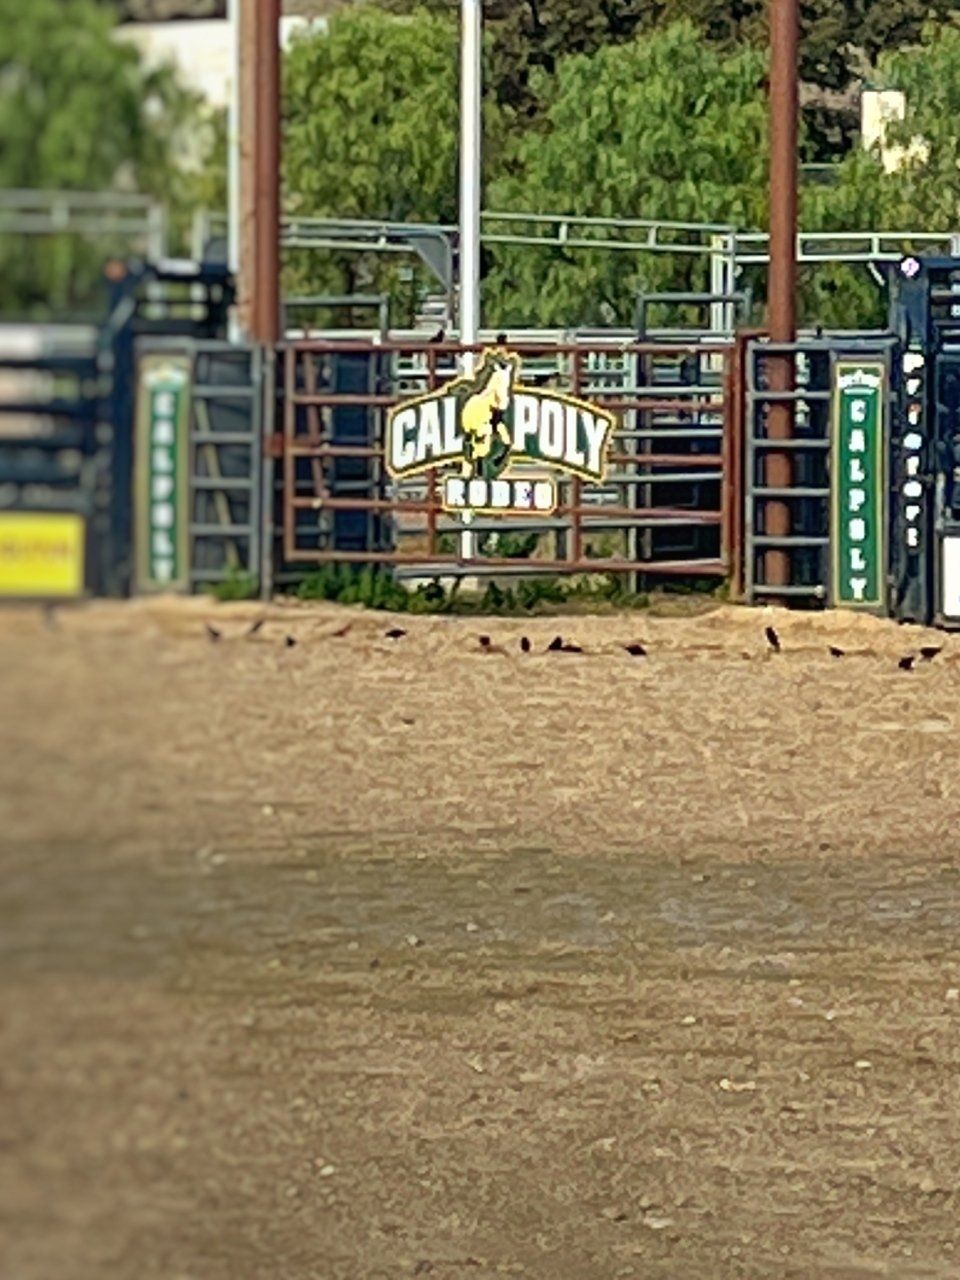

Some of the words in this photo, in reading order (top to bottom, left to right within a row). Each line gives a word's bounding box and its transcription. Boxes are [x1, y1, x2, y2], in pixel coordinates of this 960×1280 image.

[391, 395, 464, 470] CAL
[513, 393, 609, 473] POLY
[447, 478, 552, 510] RODEO
